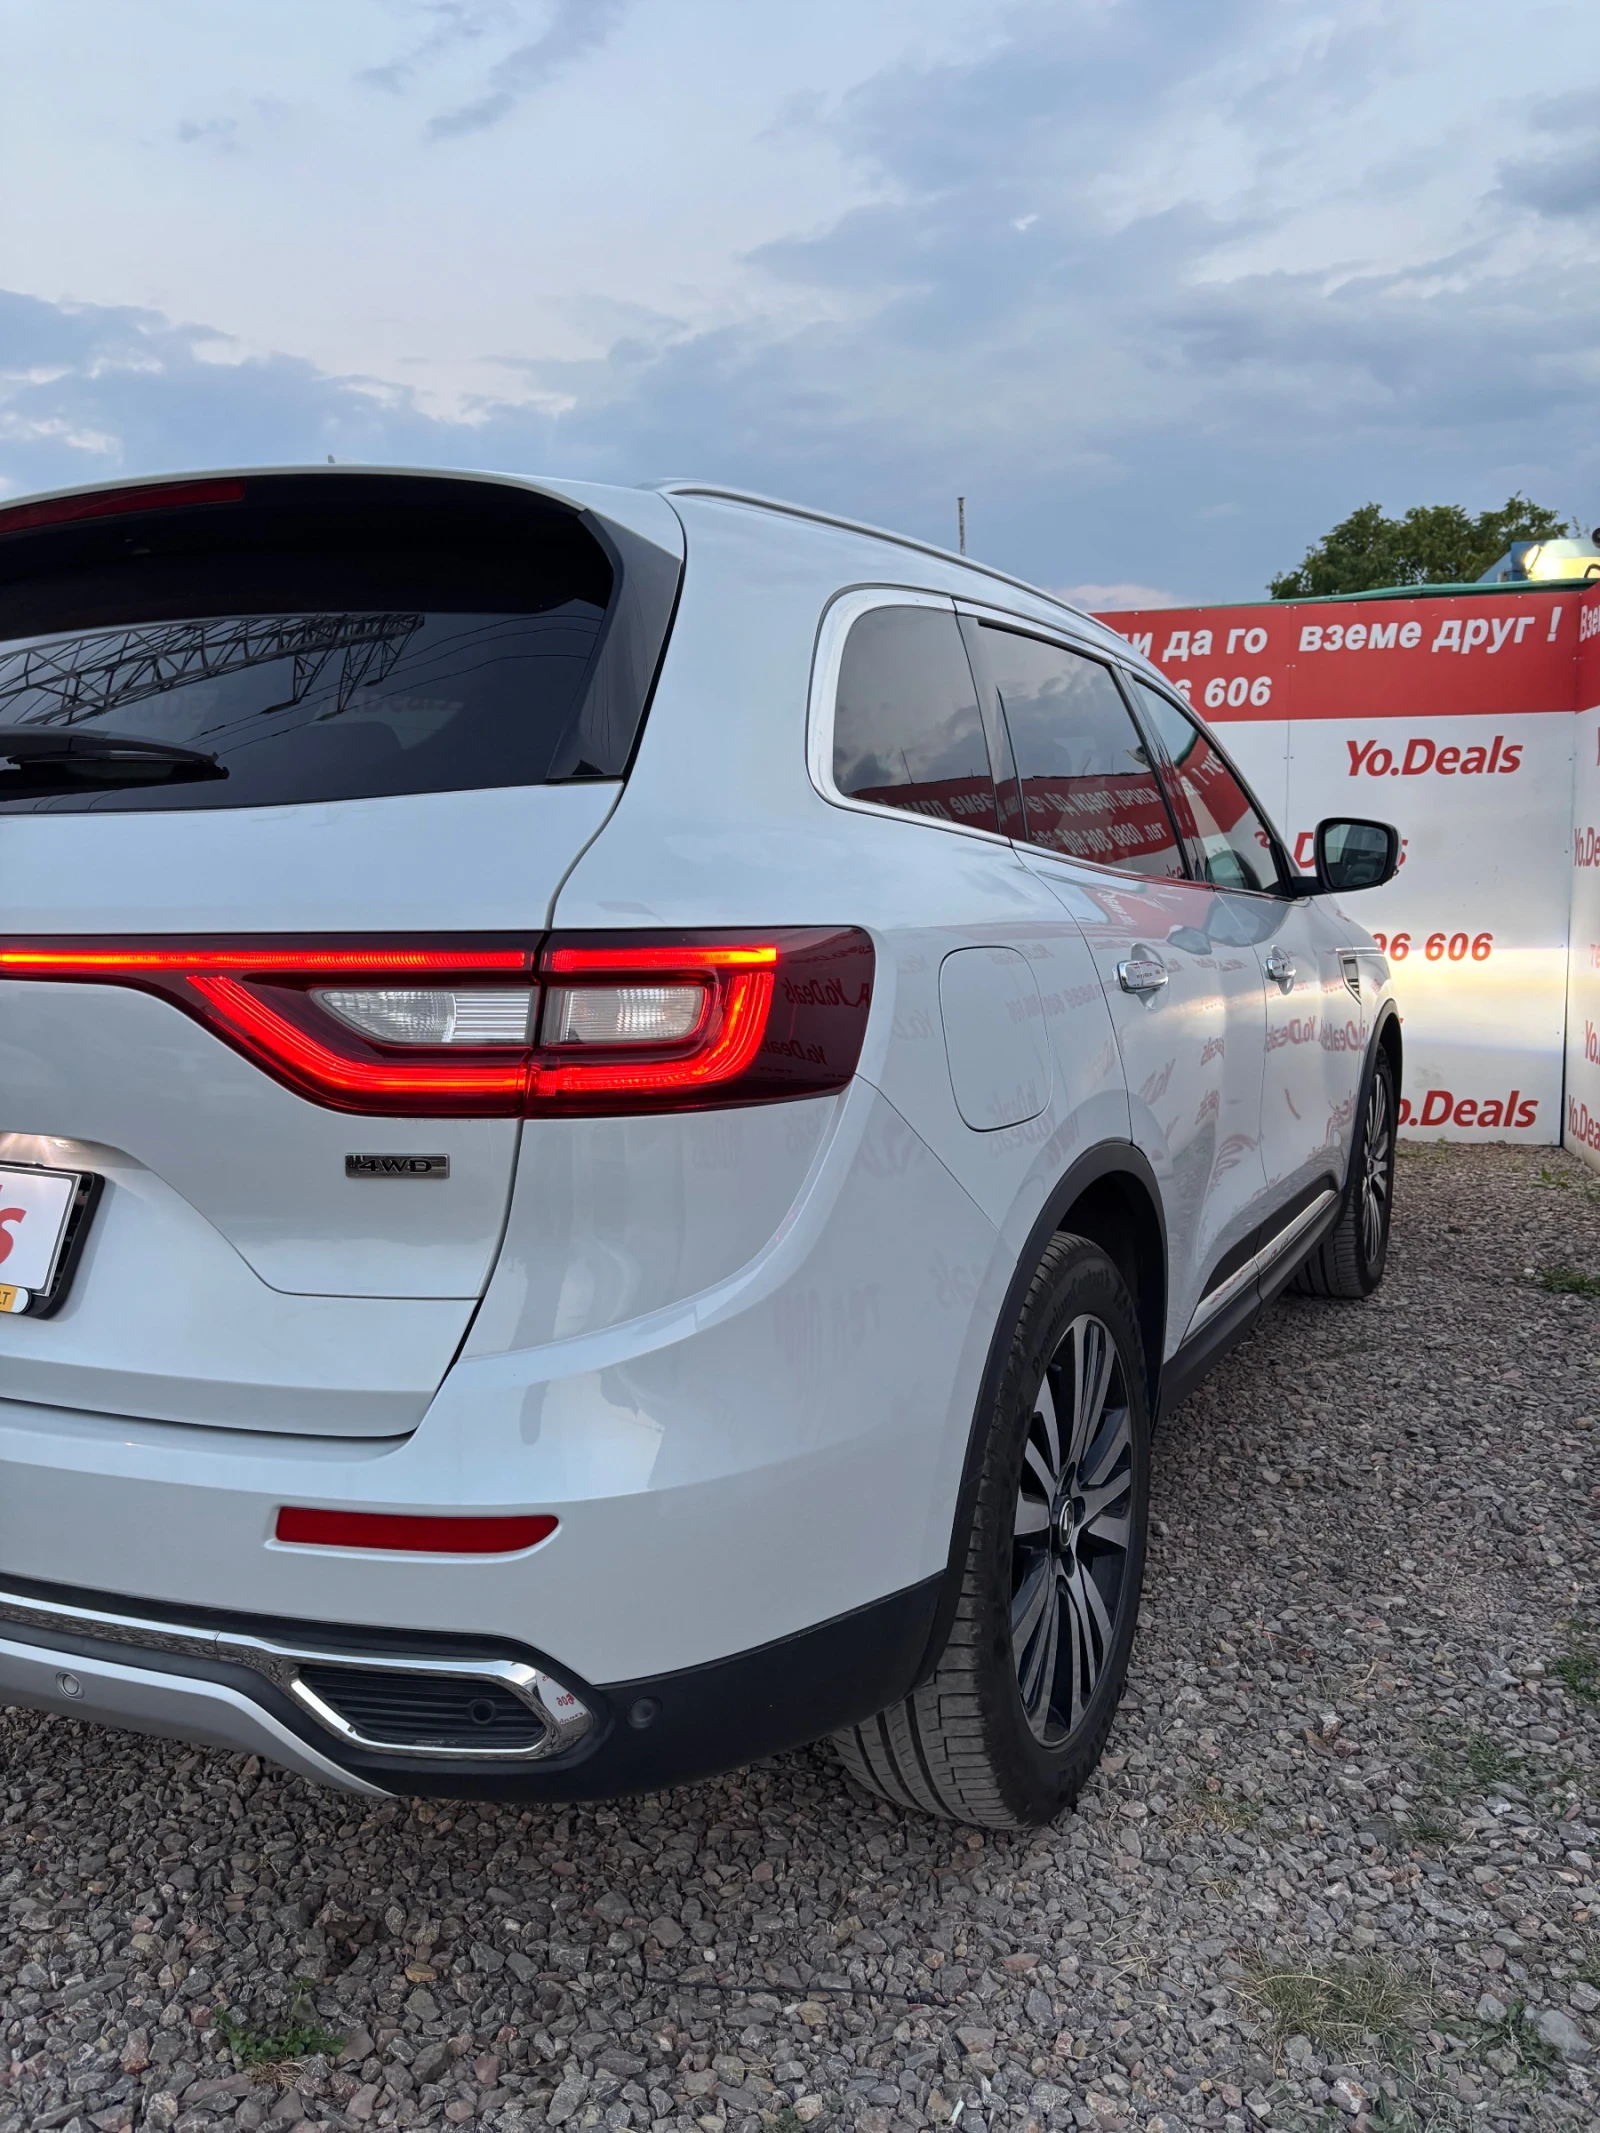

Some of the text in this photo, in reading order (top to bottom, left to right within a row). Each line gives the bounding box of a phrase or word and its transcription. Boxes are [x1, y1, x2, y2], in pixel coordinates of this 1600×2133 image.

[1162, 629, 1213, 662] да
[1226, 627, 1268, 654] го
[1298, 621, 1422, 652] вземе
[1431, 616, 1535, 654] друг
[1579, 604, 1600, 642] Взе
[1204, 676, 1272, 708] 606
[1346, 735, 1524, 777] Yo.Deals
[1425, 932, 1493, 961] 606
[1397, 1090, 1539, 1128] o.Deals
[358, 1157, 433, 1174] 4WD
